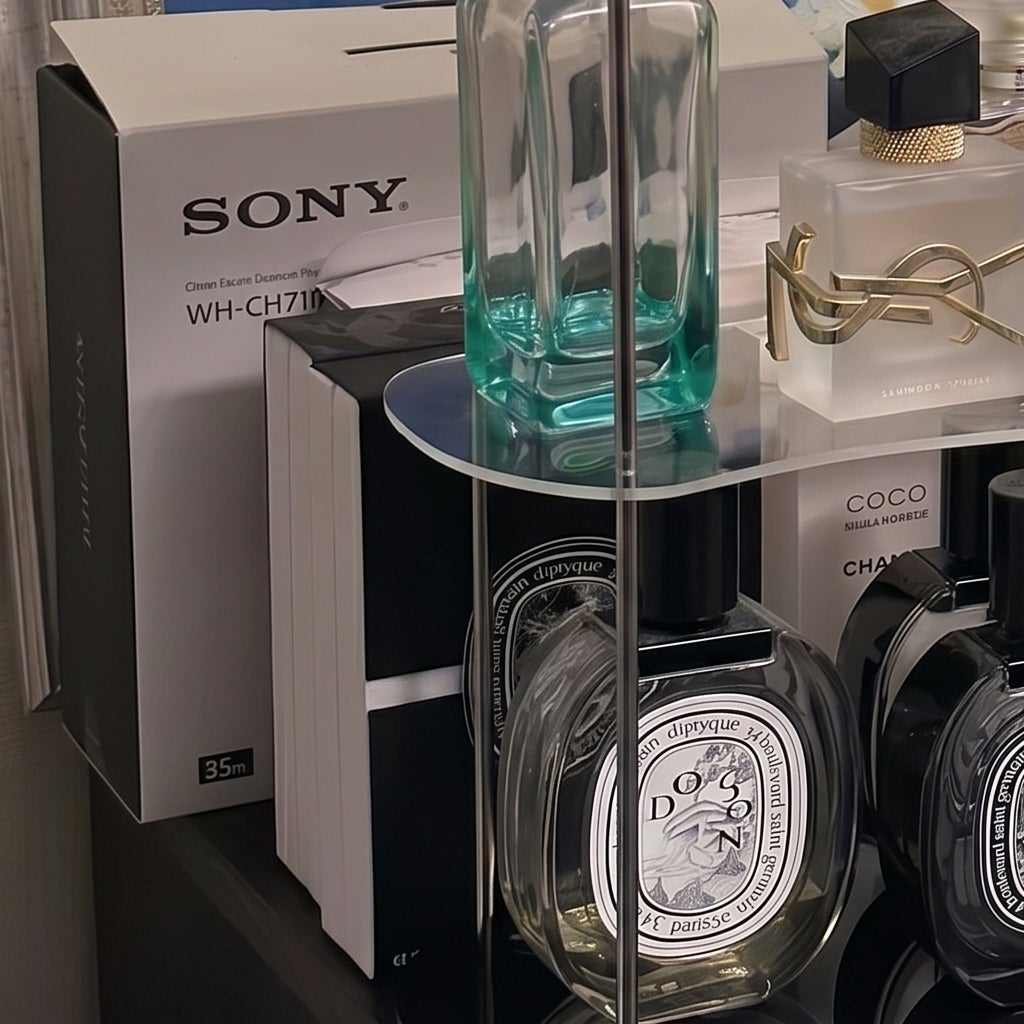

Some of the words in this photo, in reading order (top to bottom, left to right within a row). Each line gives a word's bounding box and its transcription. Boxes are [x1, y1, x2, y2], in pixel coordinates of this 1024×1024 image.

[183, 177, 407, 236] SONY
[846, 484, 927, 513] COCO
[205, 757, 246, 779] 35m
